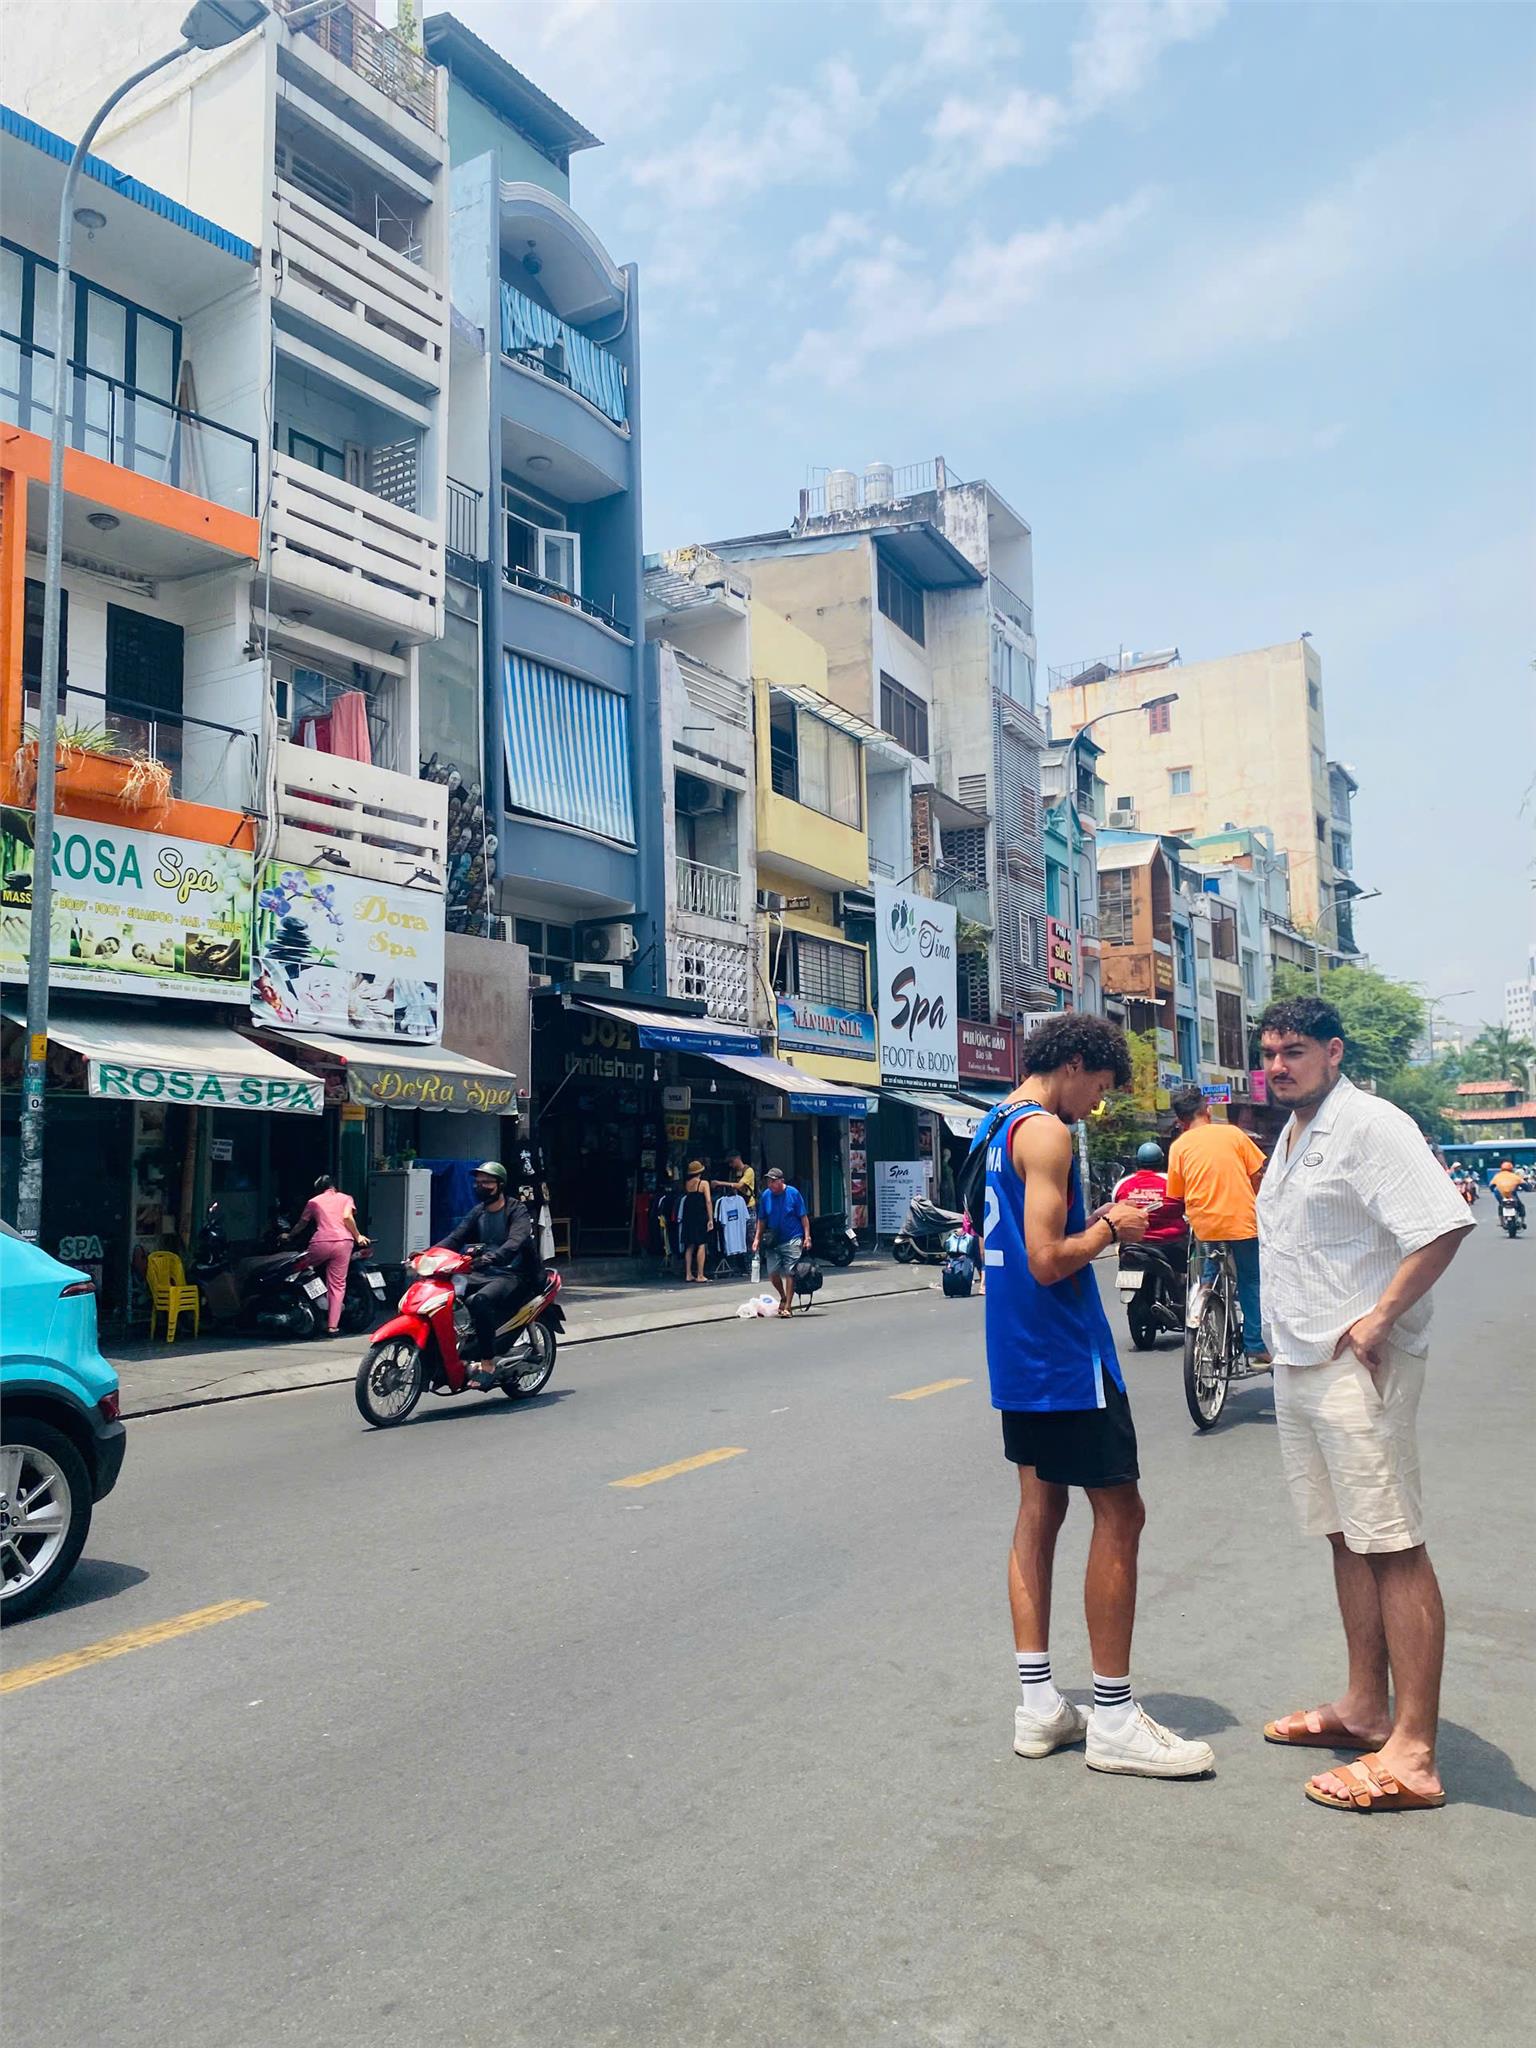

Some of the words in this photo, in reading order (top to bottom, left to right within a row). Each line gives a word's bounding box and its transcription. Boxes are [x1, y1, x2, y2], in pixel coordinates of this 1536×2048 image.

[154, 847, 218, 904] Spa
[3, 890, 32, 904] MASS
[352, 895, 430, 932] Dora
[367, 930, 417, 960] Spa
[918, 919, 951, 960] Tina
[891, 965, 948, 1042] Spa
[882, 1045, 914, 1068] FOOT
[917, 1051, 925, 1069] &
[928, 1051, 956, 1073] BODY
[99, 1063, 226, 1103] ROSA
[237, 1077, 316, 1110] SPA
[463, 1077, 511, 1113] Spa
[889, 1165, 909, 1178] Spa
[59, 1235, 104, 1260] SPA
